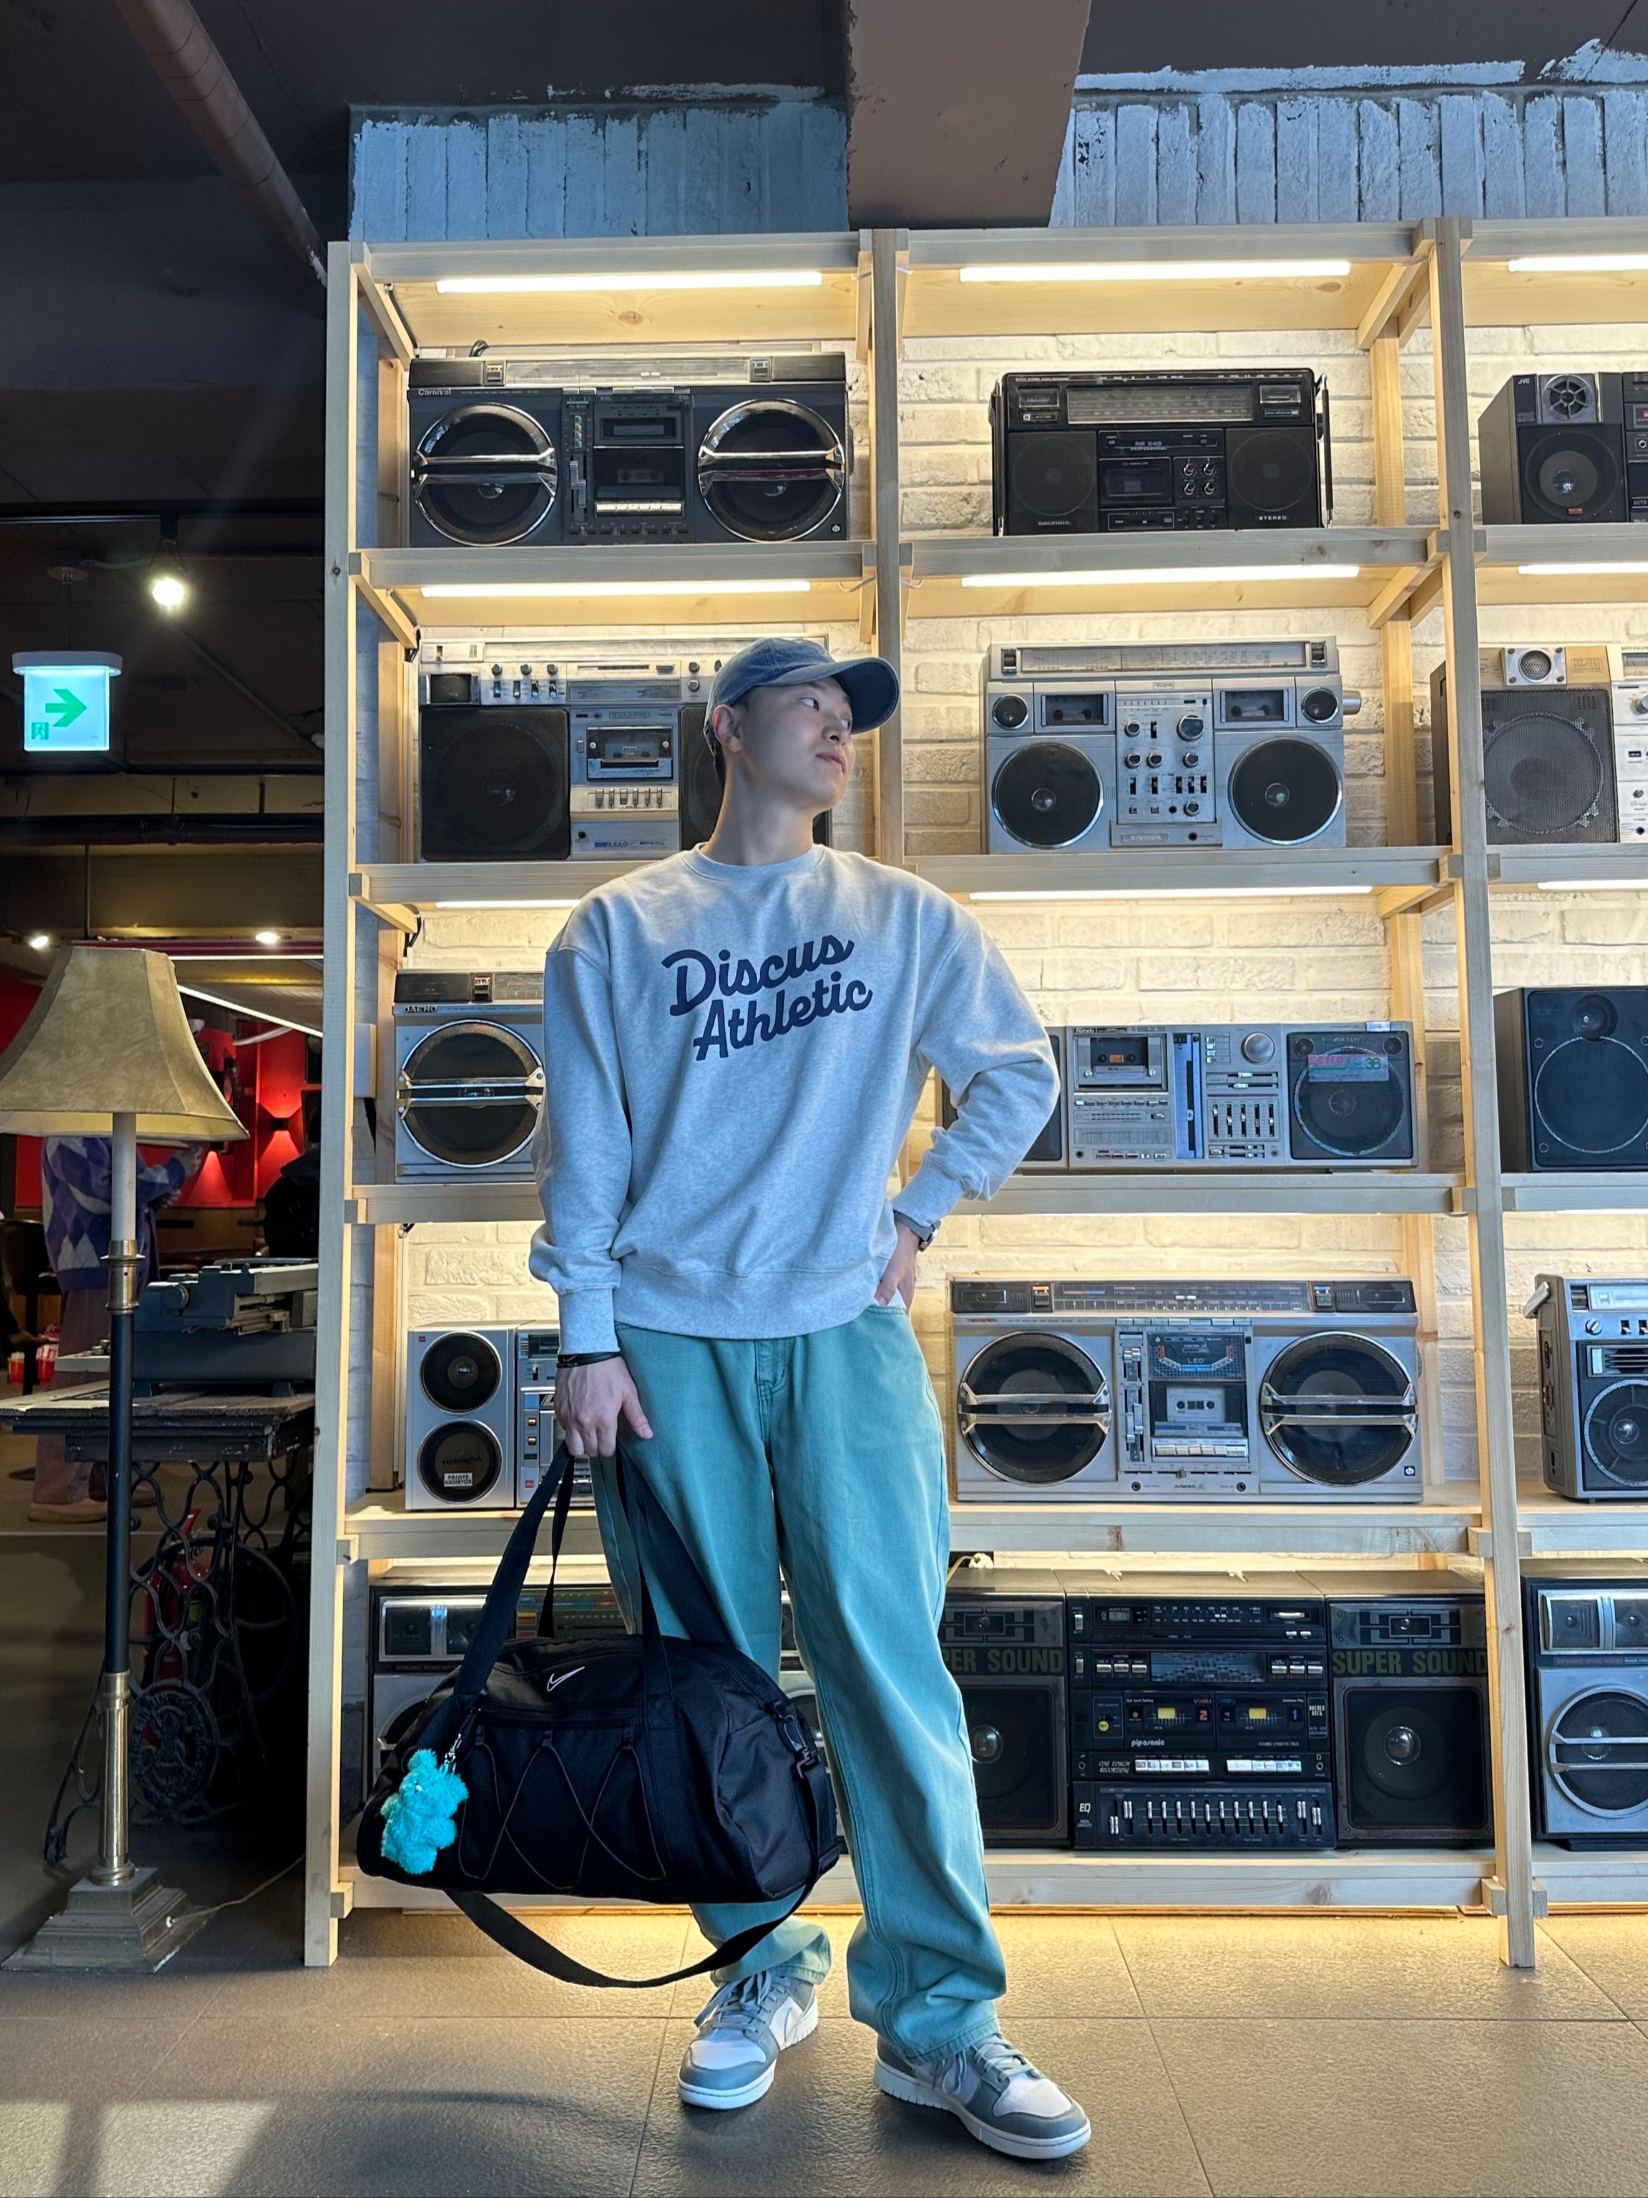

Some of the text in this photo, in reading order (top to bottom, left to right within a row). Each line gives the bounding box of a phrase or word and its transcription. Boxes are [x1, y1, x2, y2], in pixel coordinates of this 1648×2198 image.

[418, 388, 452, 396] Carnival
[661, 934, 855, 1017] Discus
[693, 970, 874, 1061] Athletic
[1365, 1057, 1381, 1070] 36
[942, 1649, 1064, 1672] PER SOUND
[1331, 1650, 1488, 1674] SUPER SOUND
[1199, 1710, 1208, 1721] 2
[1079, 1803, 1091, 1813] EQ
